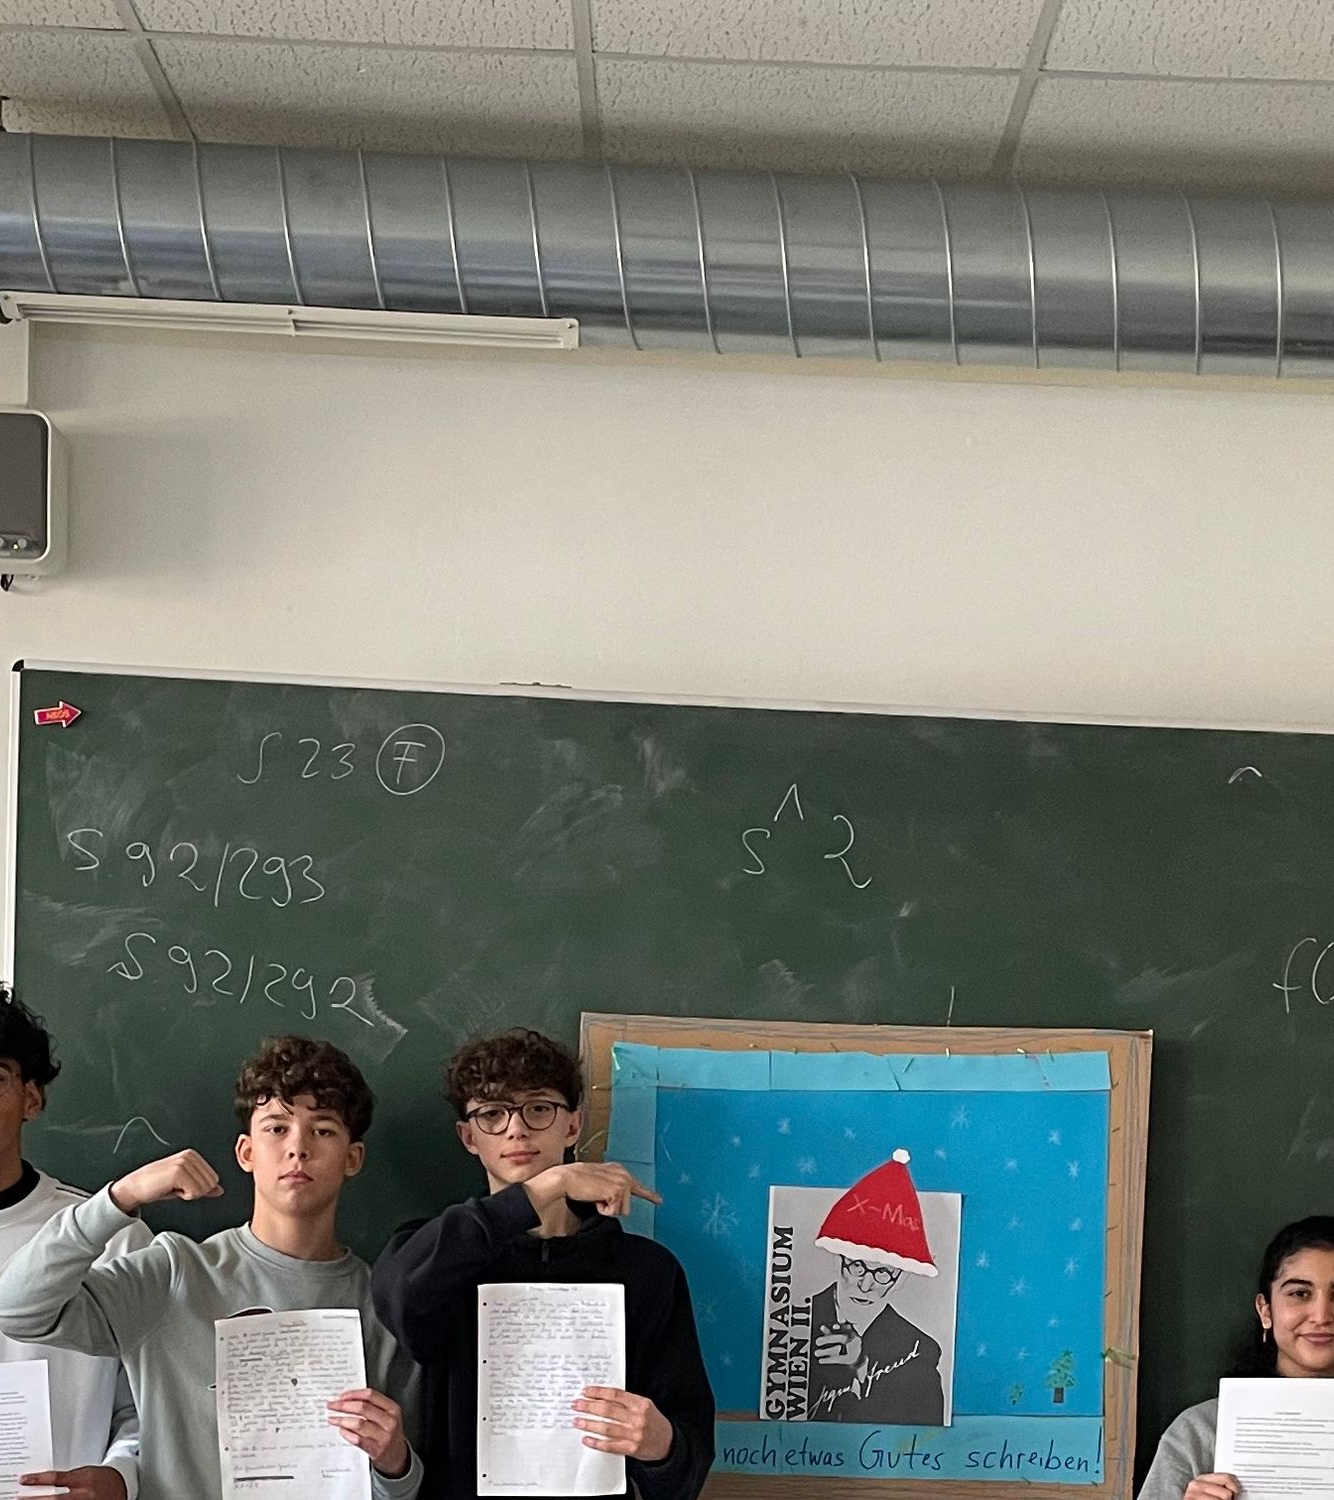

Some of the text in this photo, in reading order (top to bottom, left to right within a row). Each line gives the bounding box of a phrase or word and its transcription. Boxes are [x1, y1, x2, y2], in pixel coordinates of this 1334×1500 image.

[298, 738, 356, 779] 23
[765, 1226, 794, 1419] GYMNASIUM
[786, 1296, 812, 1421] WIEN II.
[723, 1427, 1103, 1475] noch etwas Gutes schreiben!
